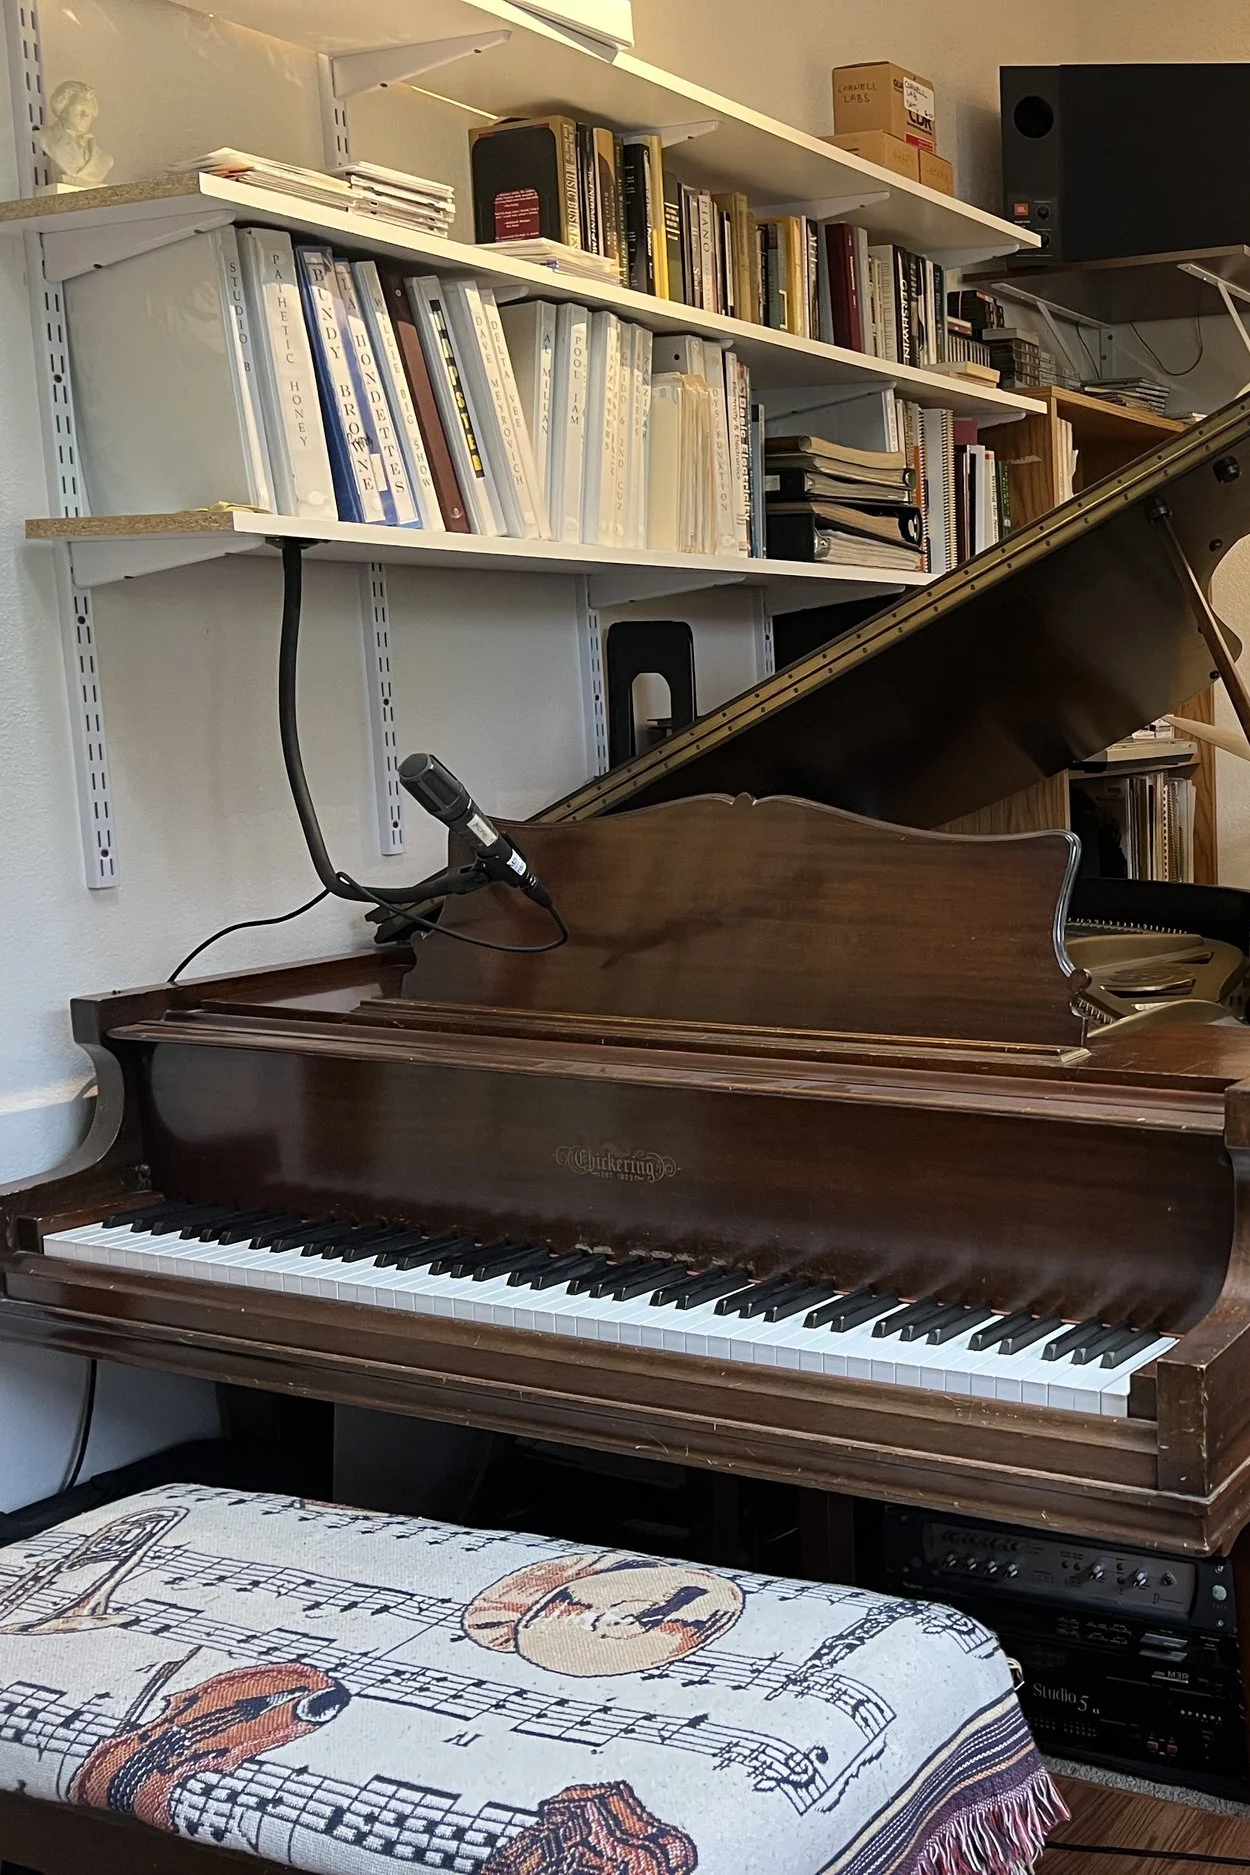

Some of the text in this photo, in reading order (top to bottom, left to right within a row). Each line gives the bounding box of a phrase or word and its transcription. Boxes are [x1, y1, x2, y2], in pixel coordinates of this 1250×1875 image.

[844, 93, 870, 103] LABS
[565, 163, 580, 249] MUSIC BUSINES
[702, 200, 710, 253] PIANO
[230, 262, 250, 372] STUDIO B
[272, 254, 308, 446] PATHETIC HONEY
[314, 268, 340, 360] BUNDY
[544, 333, 551, 354] AL
[900, 280, 910, 358] GERSHWIN
[356, 334, 405, 493] HONDETTES
[476, 316, 524, 485] DAVE MEYROVICH
[491, 321, 520, 428] DELTA VEE
[570, 336, 582, 425] POOL JAM
[401, 389, 414, 424] BIG
[414, 440, 431, 486] SHOW
[738, 396, 751, 522] Basic Electricity
[574, 1149, 656, 1182] Chickering
[1033, 1683, 1076, 1704] Studio
[1078, 1696, 1090, 1712] 5
[1168, 1670, 1190, 1680] M3R
